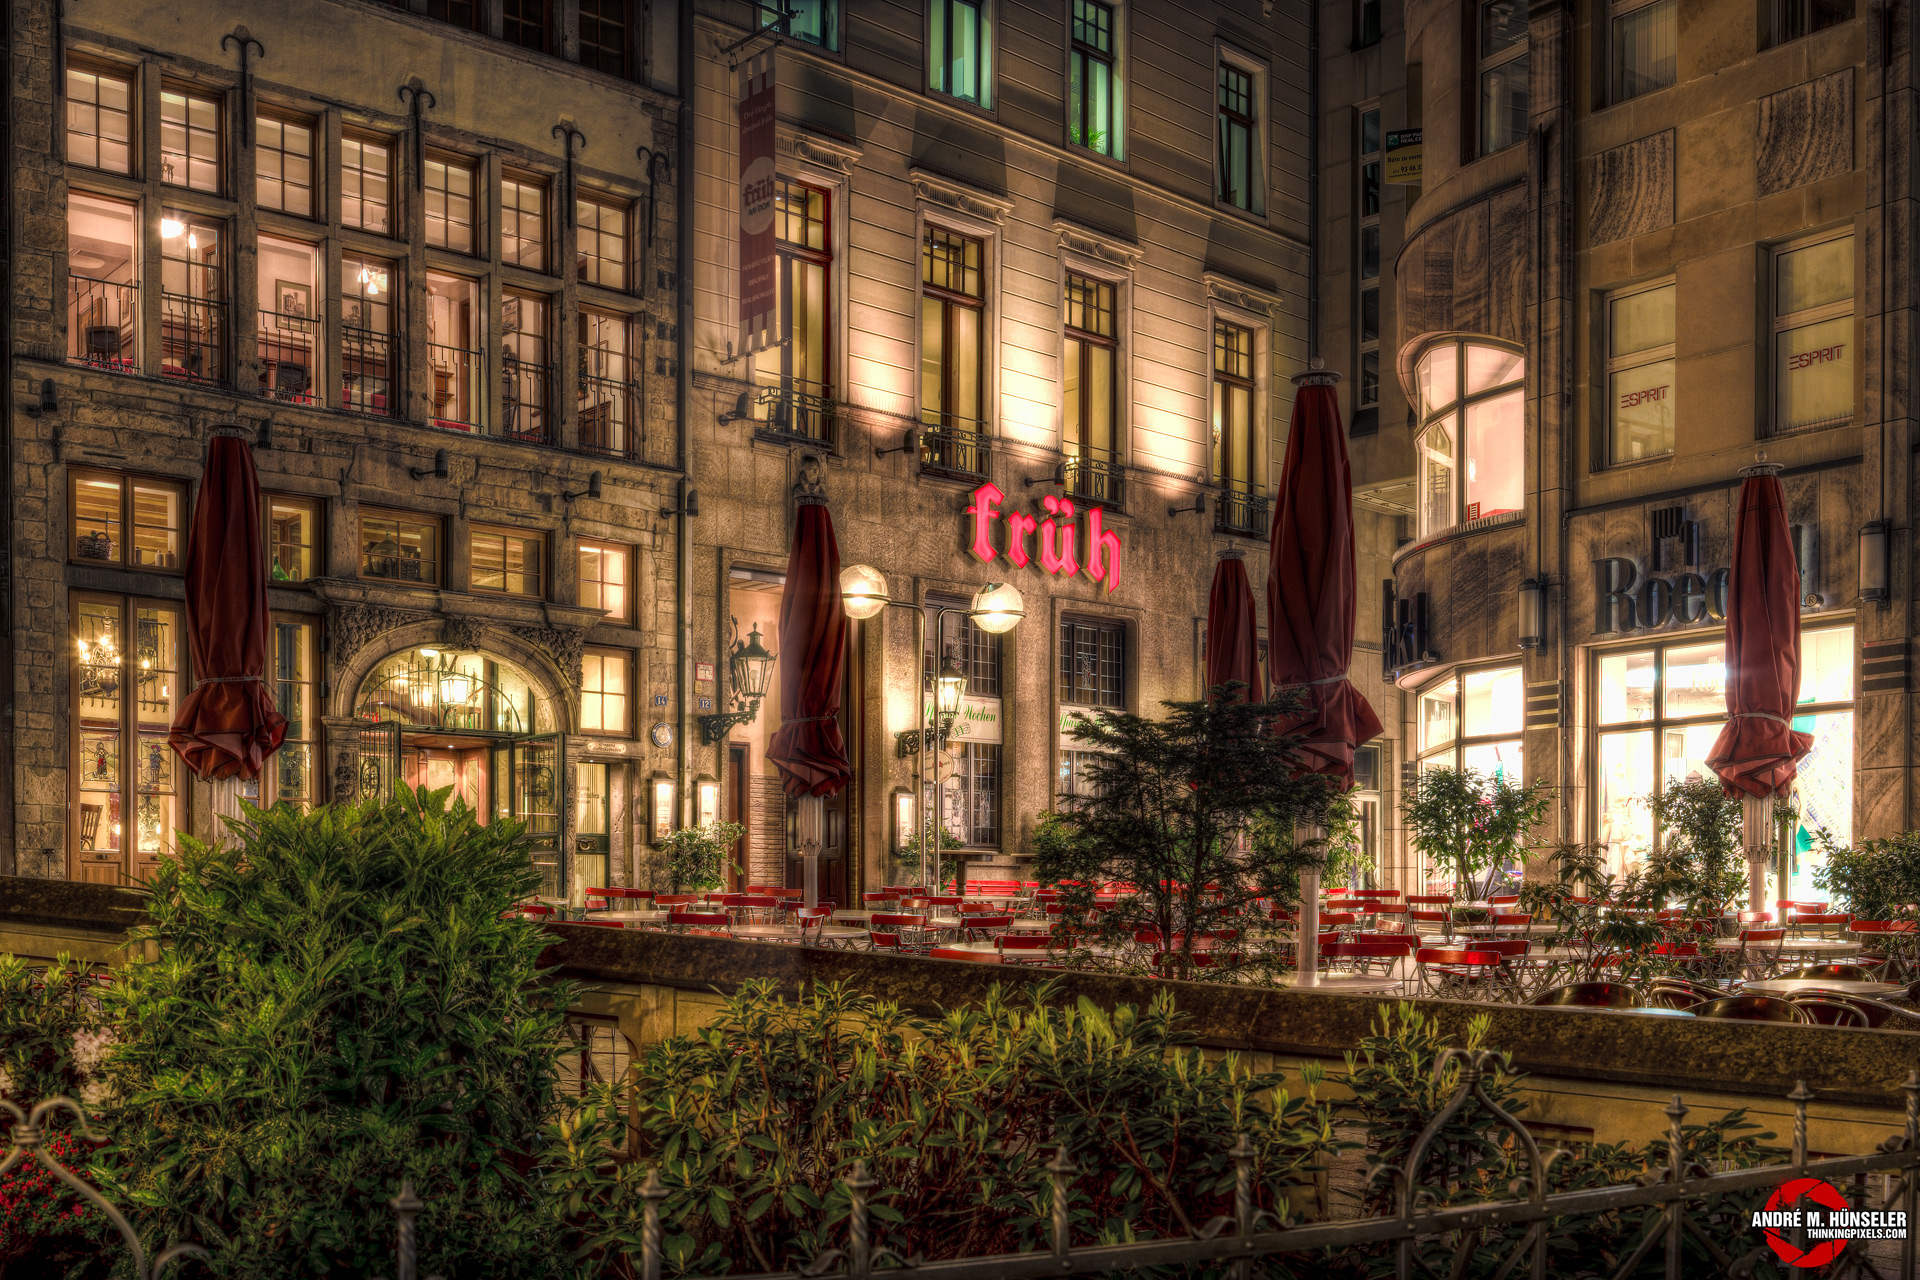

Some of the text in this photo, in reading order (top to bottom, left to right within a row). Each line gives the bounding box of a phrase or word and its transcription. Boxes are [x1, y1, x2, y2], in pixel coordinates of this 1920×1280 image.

[743, 174, 775, 207] früh
[1789, 344, 1845, 370] ESPRIT
[1621, 385, 1669, 409] ESPRIT
[964, 482, 1121, 595] früh
[701, 700, 710, 708] 12
[963, 704, 996, 722] Wochen
